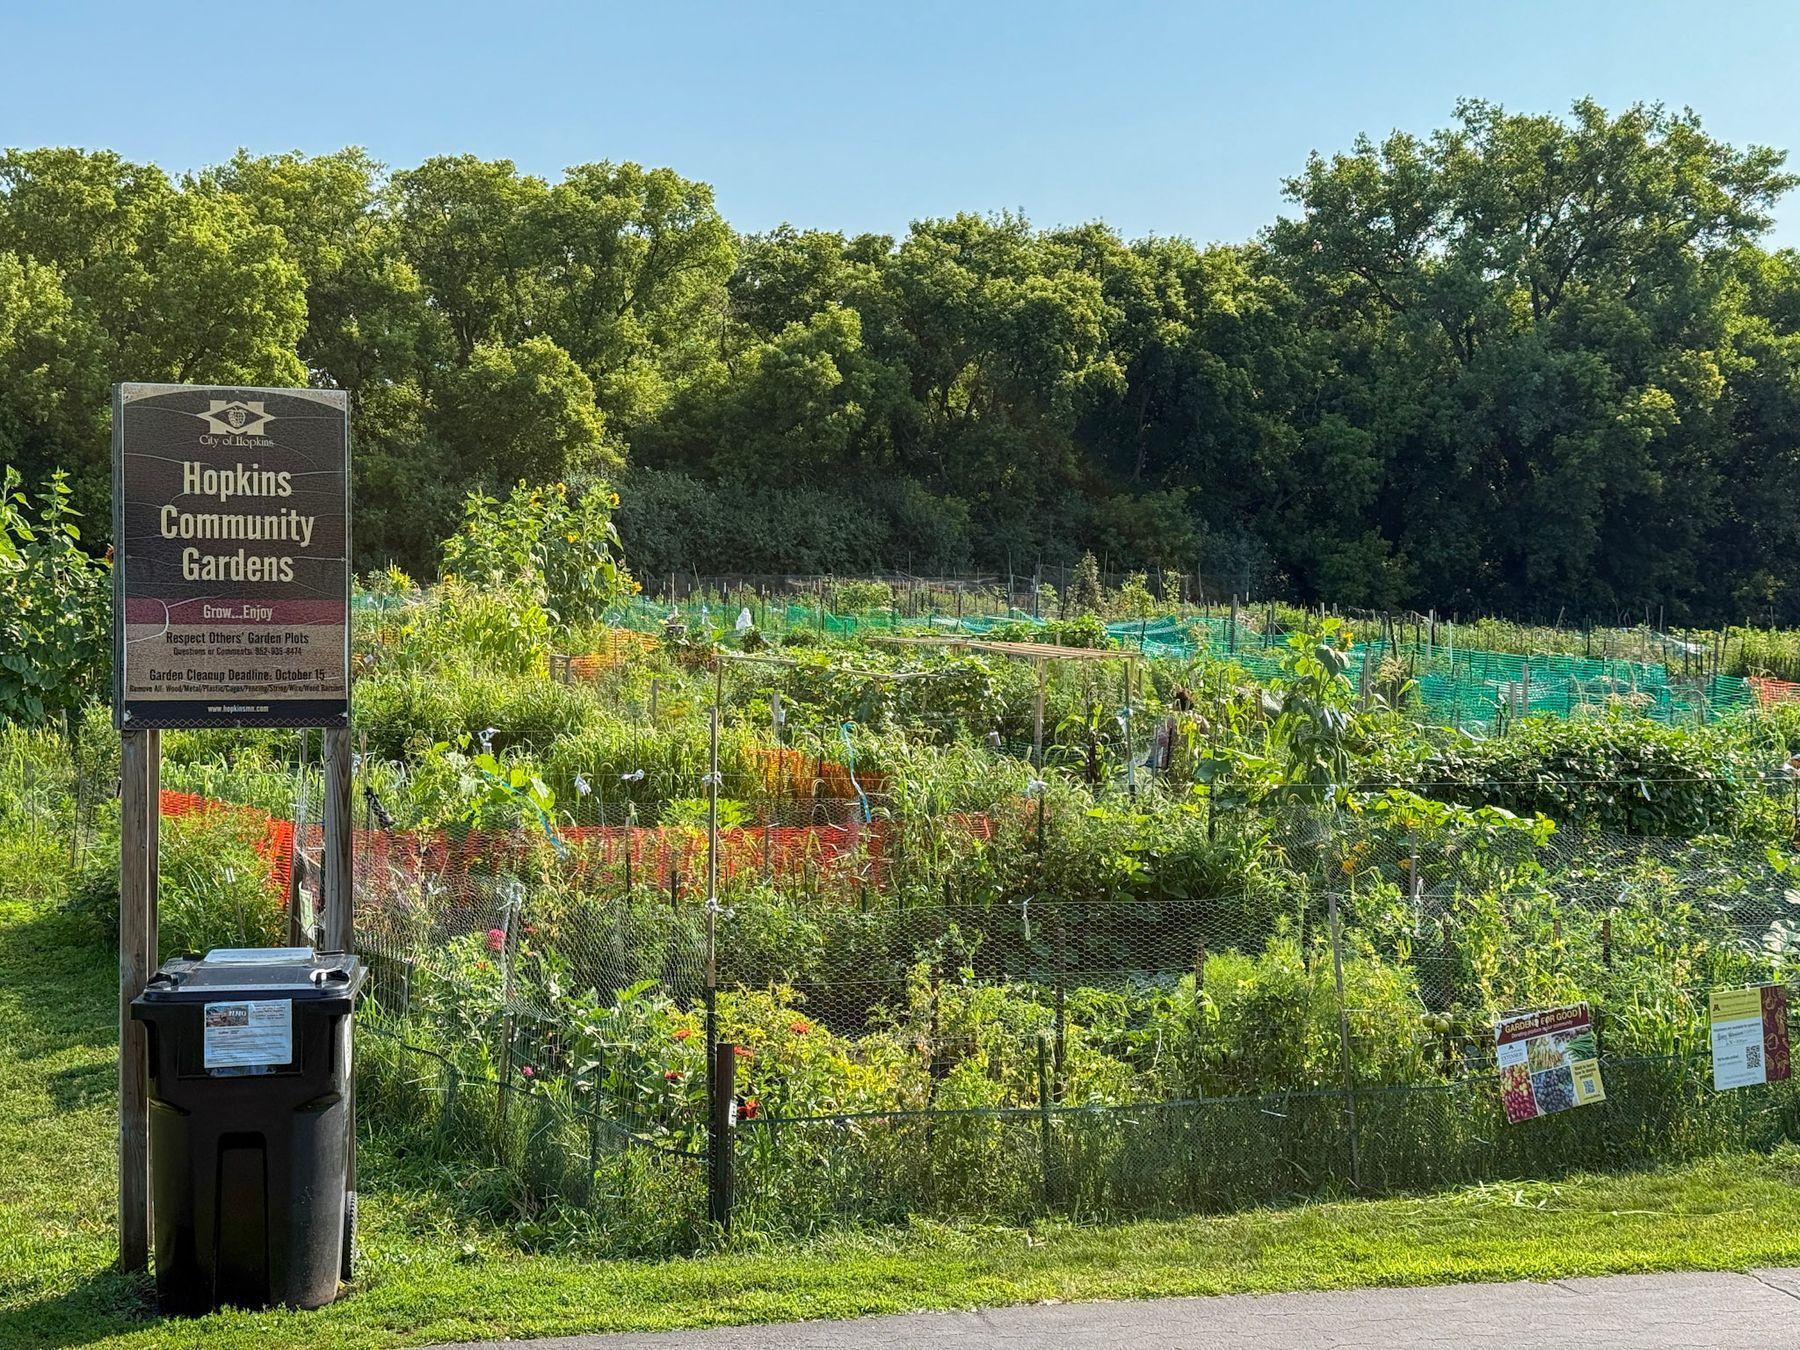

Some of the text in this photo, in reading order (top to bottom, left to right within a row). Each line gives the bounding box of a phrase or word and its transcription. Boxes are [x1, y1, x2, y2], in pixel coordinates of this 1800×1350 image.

[199, 434, 273, 449] City of Hopkins
[183, 461, 292, 502] Hopkins
[160, 504, 315, 547] Community
[182, 547, 294, 582] Gardens
[166, 632, 206, 645] Respect
[247, 632, 281, 645] Garden
[285, 632, 309, 645] Plots
[173, 647, 206, 656] Questions
[149, 668, 325, 683] Garden Cleanup Deadline: October 15
[207, 704, 269, 714] www.hopkinsmn.com
[1505, 1018, 1539, 1033] GARDEN
[1556, 1010, 1578, 1020] GOOD
